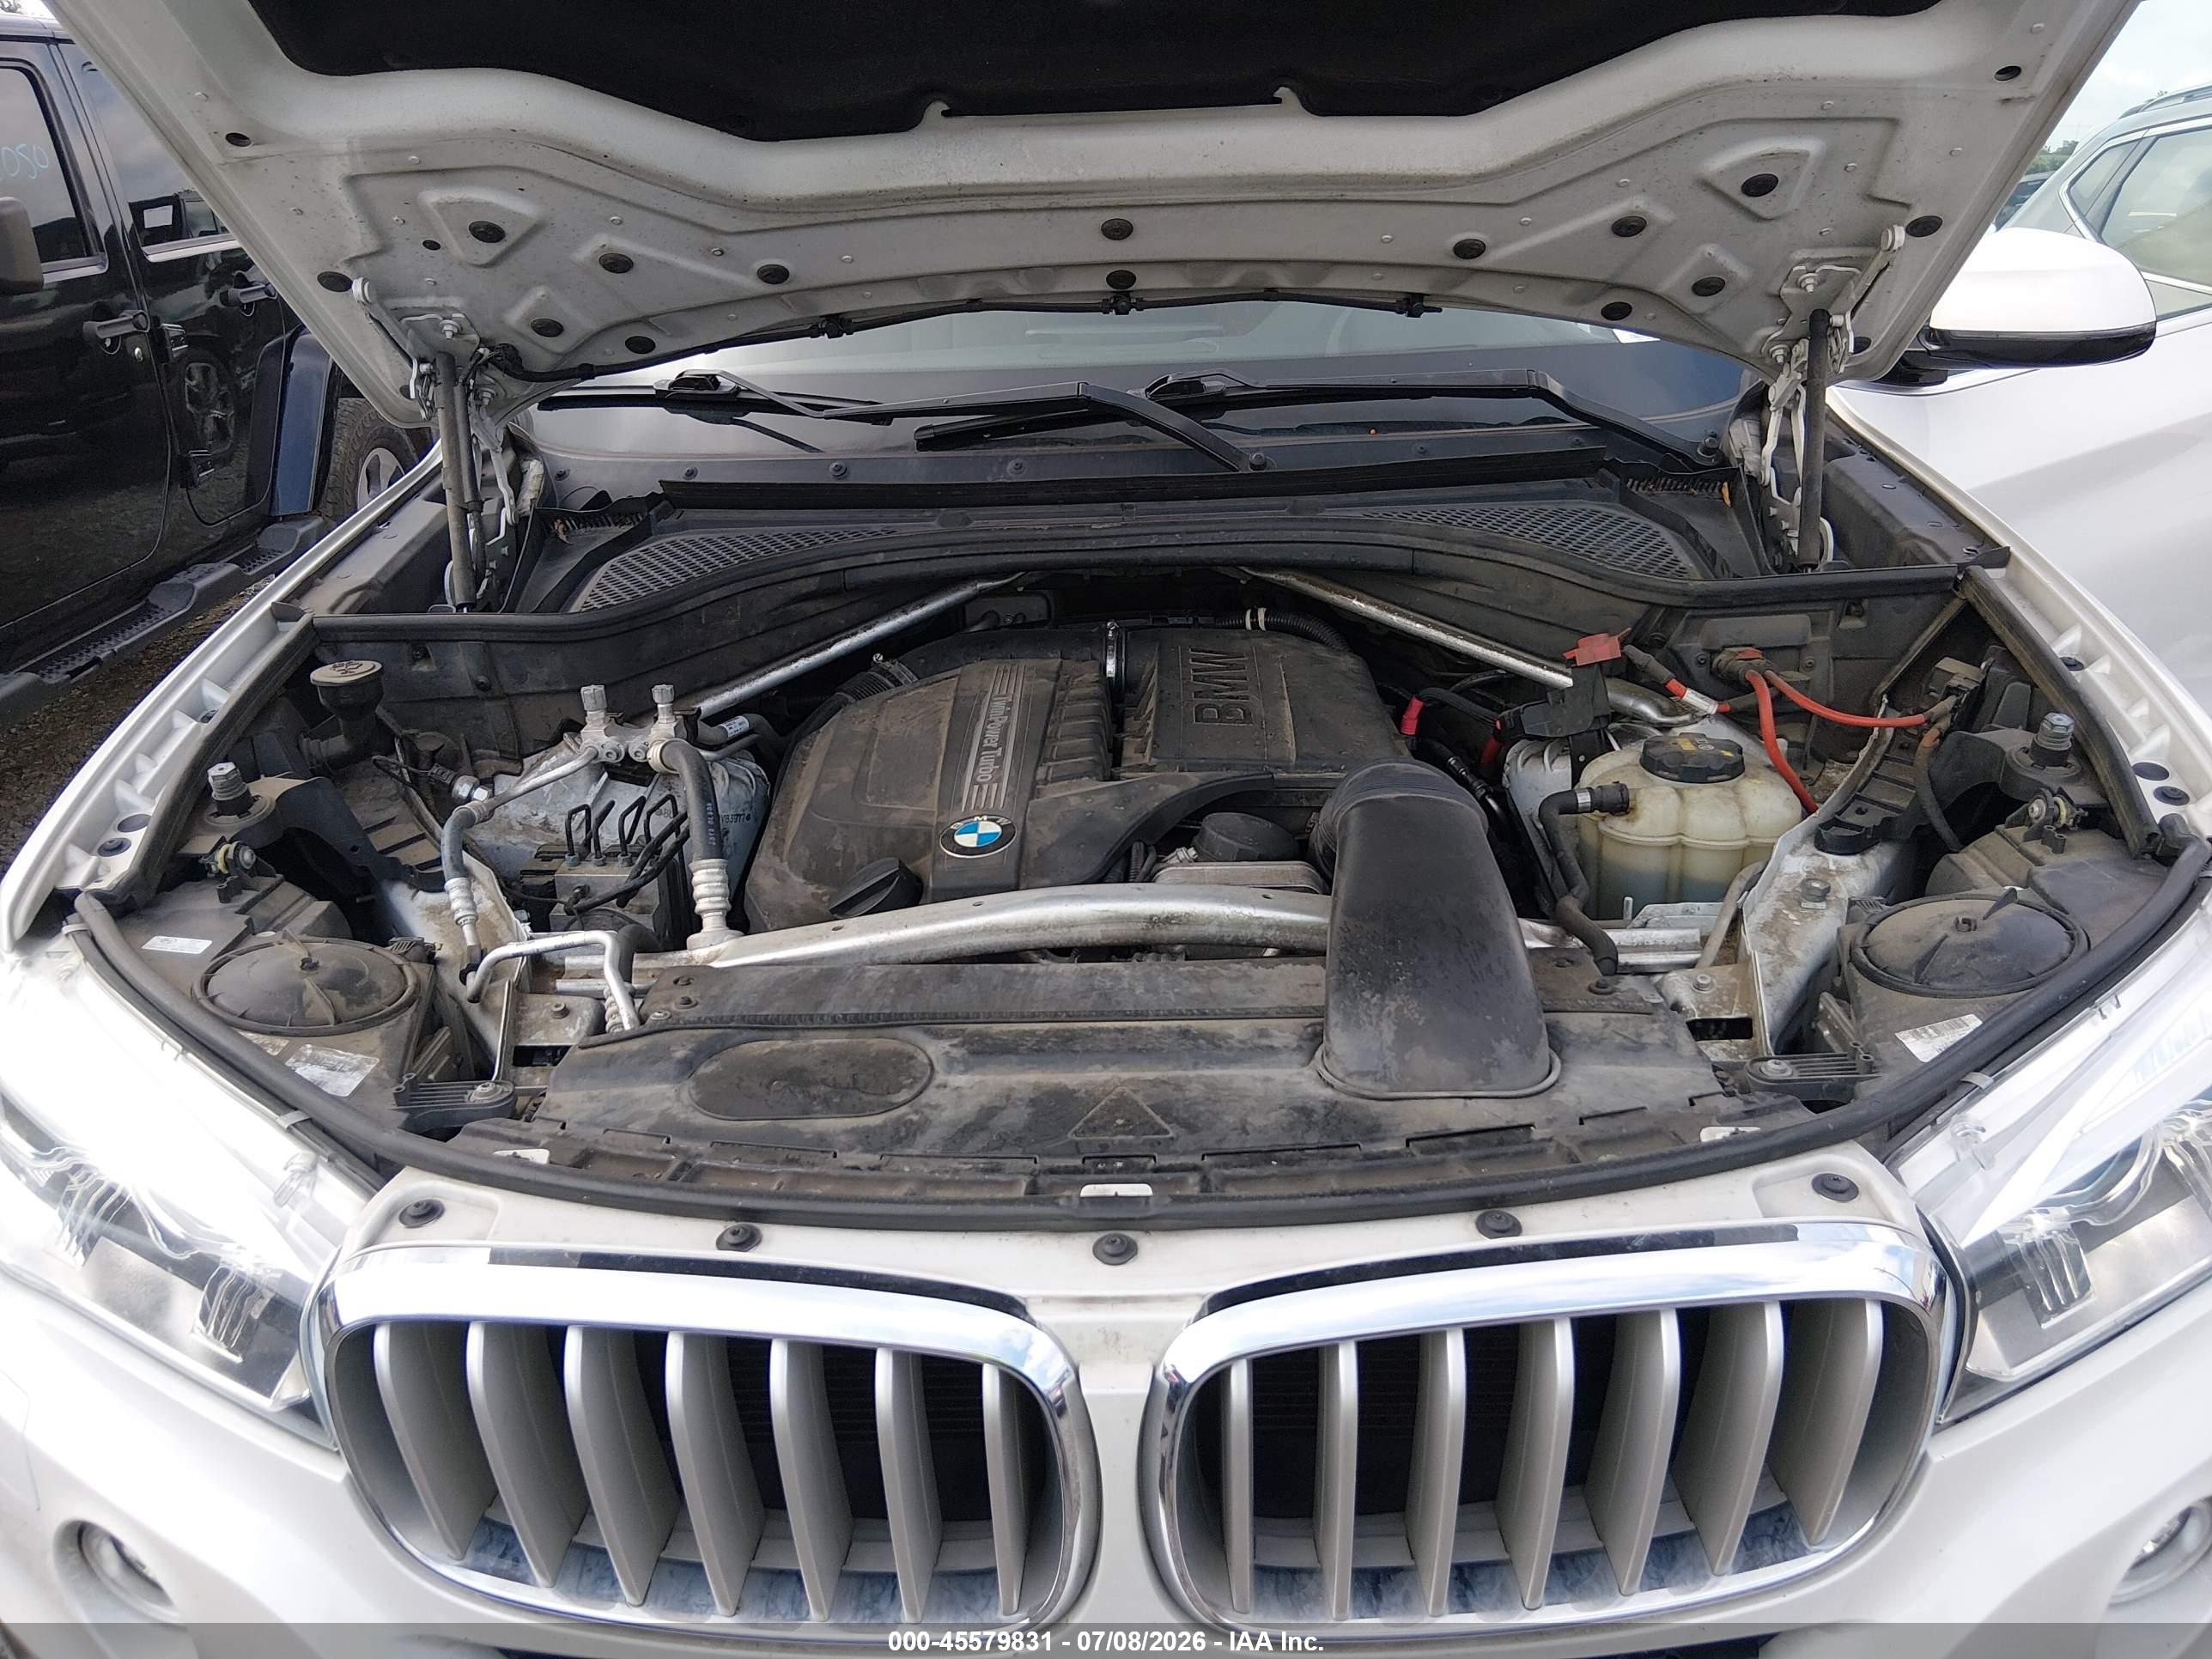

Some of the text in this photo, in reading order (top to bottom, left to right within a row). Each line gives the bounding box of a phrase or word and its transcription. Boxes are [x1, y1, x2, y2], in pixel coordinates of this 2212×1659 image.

[1188, 646, 1253, 726] BMW
[975, 694, 1012, 782] TwinPower Turbo
